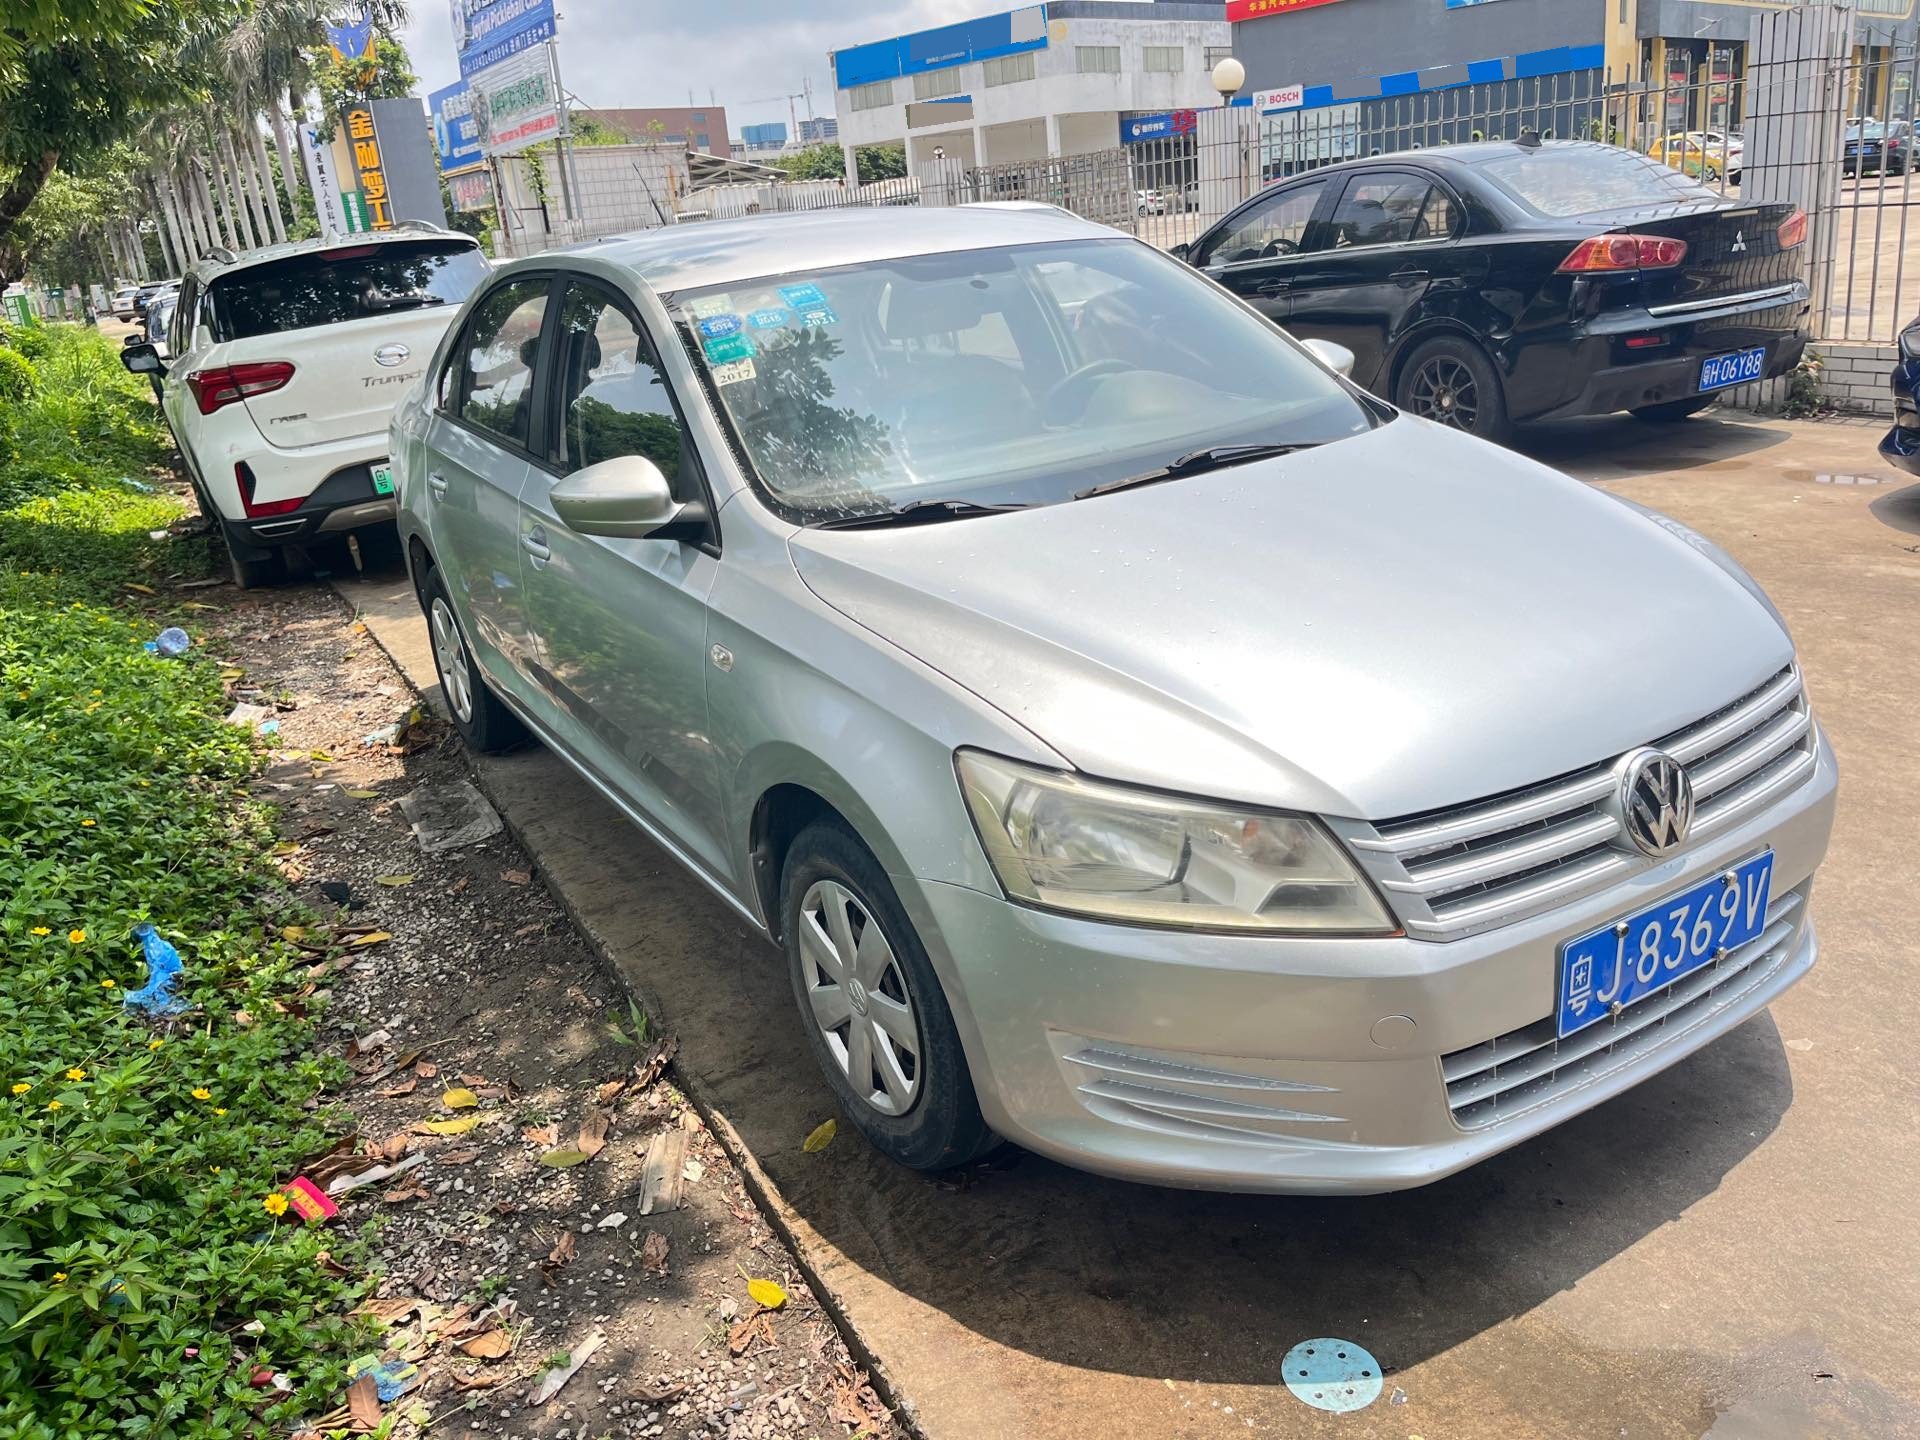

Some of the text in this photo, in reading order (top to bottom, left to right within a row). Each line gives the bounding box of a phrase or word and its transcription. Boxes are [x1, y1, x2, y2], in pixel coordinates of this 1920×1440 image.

[1269, 91, 1299, 104] BOSCH
[347, 109, 392, 231] 金刚梦工
[806, 315, 836, 328] 2021
[720, 369, 751, 384] 2017
[374, 466, 390, 490] 粤
